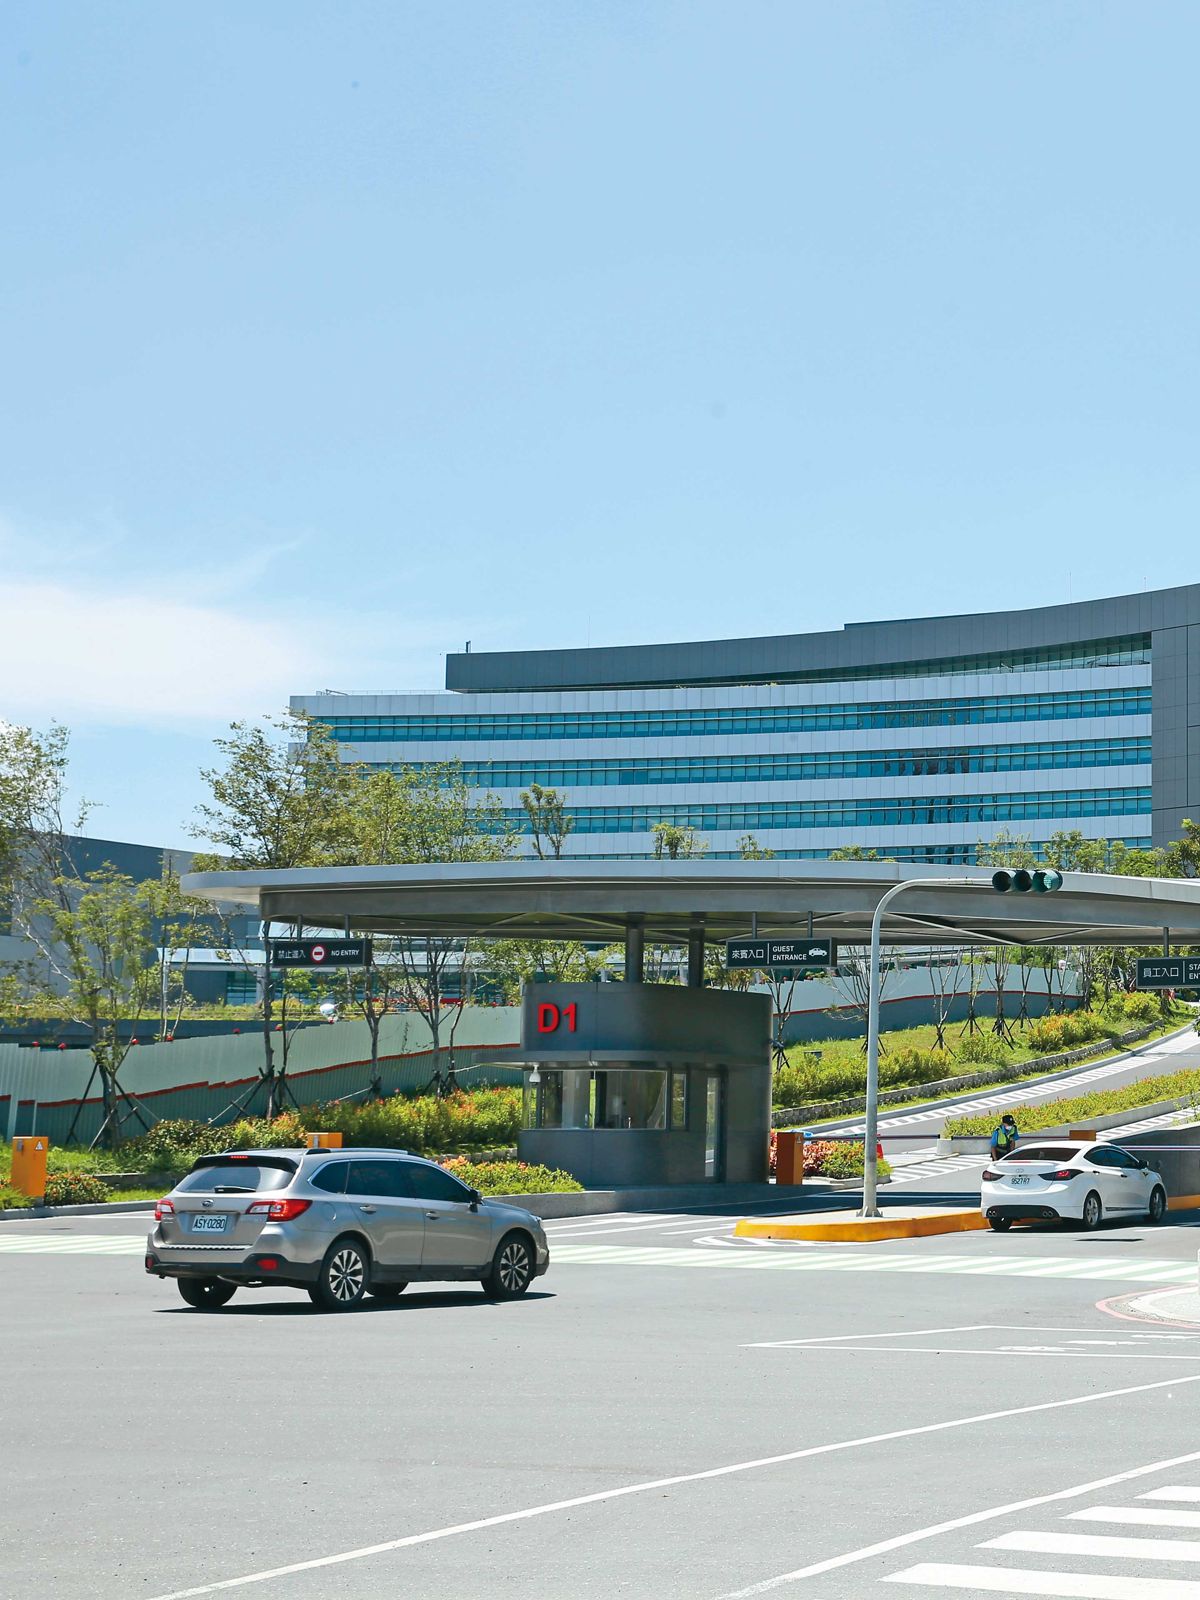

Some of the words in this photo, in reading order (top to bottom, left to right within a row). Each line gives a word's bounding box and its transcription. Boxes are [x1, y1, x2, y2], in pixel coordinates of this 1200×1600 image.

[732, 949, 764, 959] 來賓入口
[1143, 967, 1179, 978] 員工入口
[537, 1002, 577, 1033] D1
